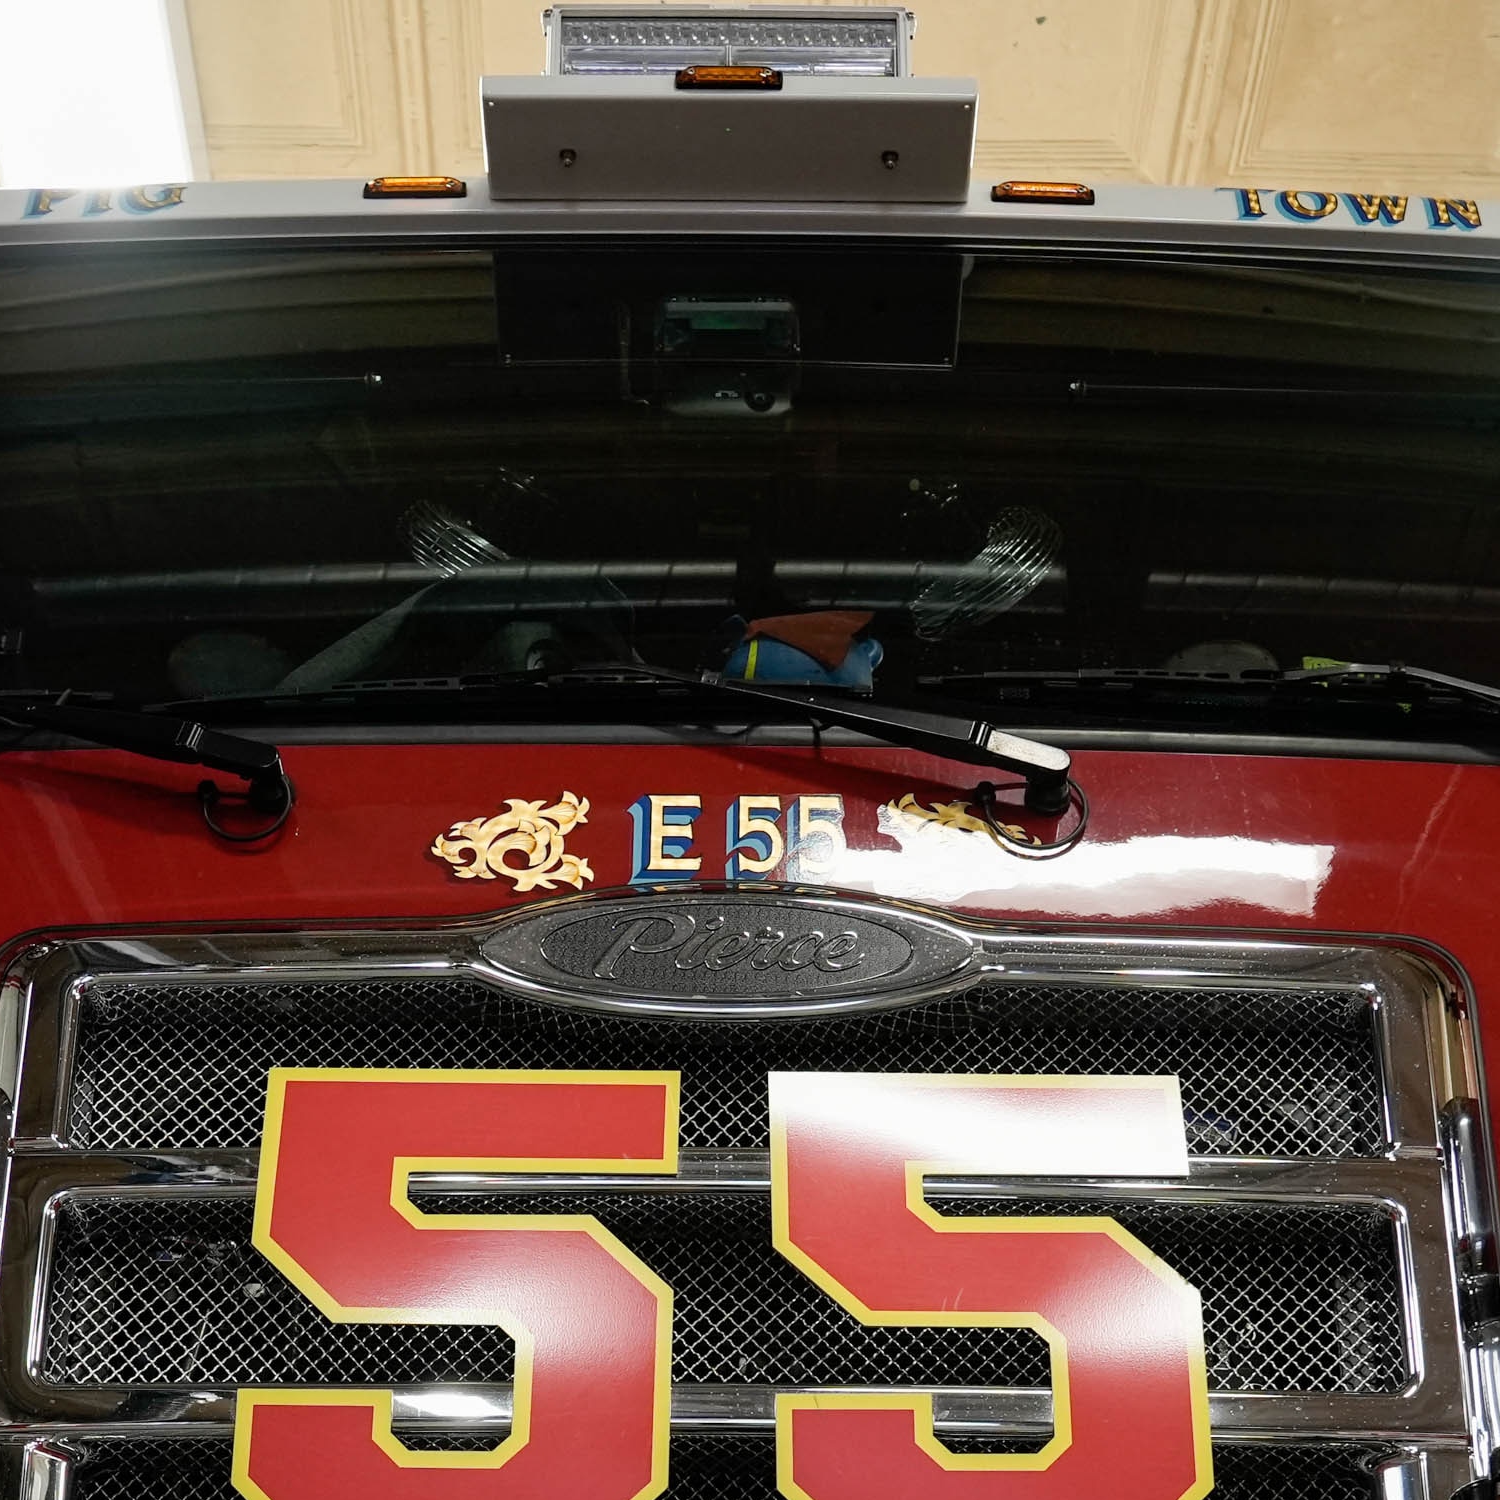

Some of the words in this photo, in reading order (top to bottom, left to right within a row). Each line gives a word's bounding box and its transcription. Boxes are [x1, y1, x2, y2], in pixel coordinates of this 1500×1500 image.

[1214, 187, 1483, 232] TOWN
[628, 794, 702, 882] E
[725, 794, 846, 882] 55
[592, 909, 866, 980] Pierce
